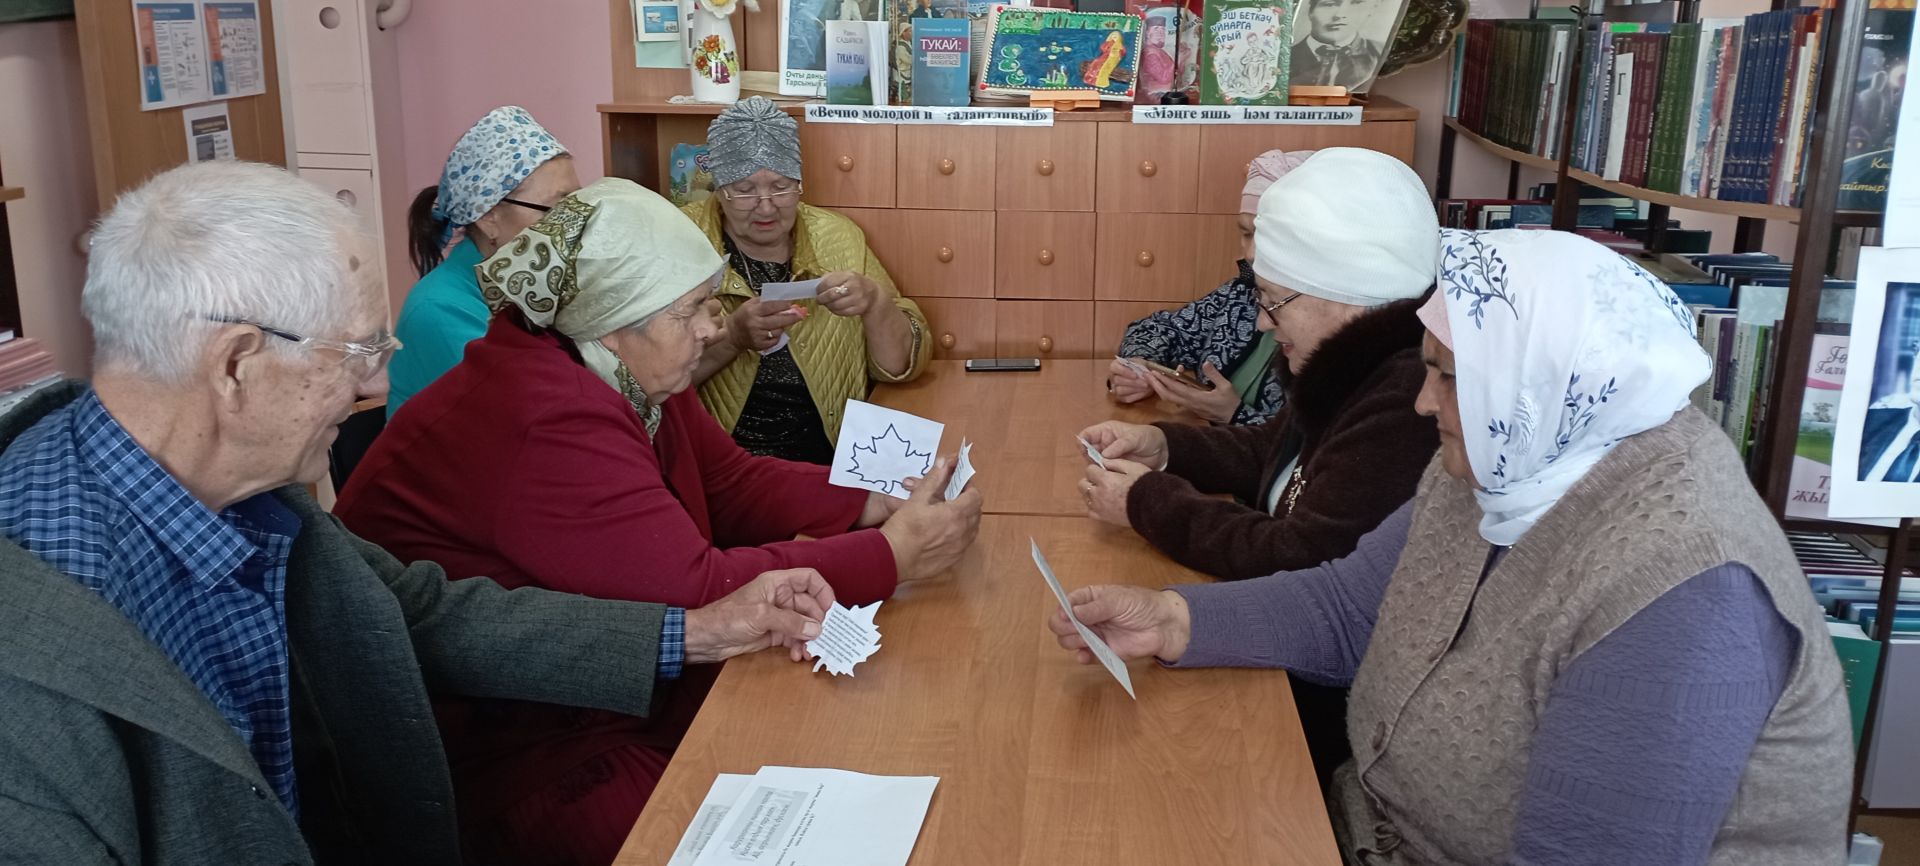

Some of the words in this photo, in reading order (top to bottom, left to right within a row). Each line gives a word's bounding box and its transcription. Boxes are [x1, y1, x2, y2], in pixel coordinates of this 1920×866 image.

[1222, 12, 1236, 20] ЭШ
[920, 37, 962, 50] ТУКАЙ:
[1215, 31, 1242, 45] ЯРЫЙ
[809, 106, 859, 118] «Вечно
[861, 109, 921, 121] молодой
[1200, 110, 1232, 120] яшь
[1243, 108, 1269, 120] һәм
[1273, 110, 1354, 120] талантлы»
